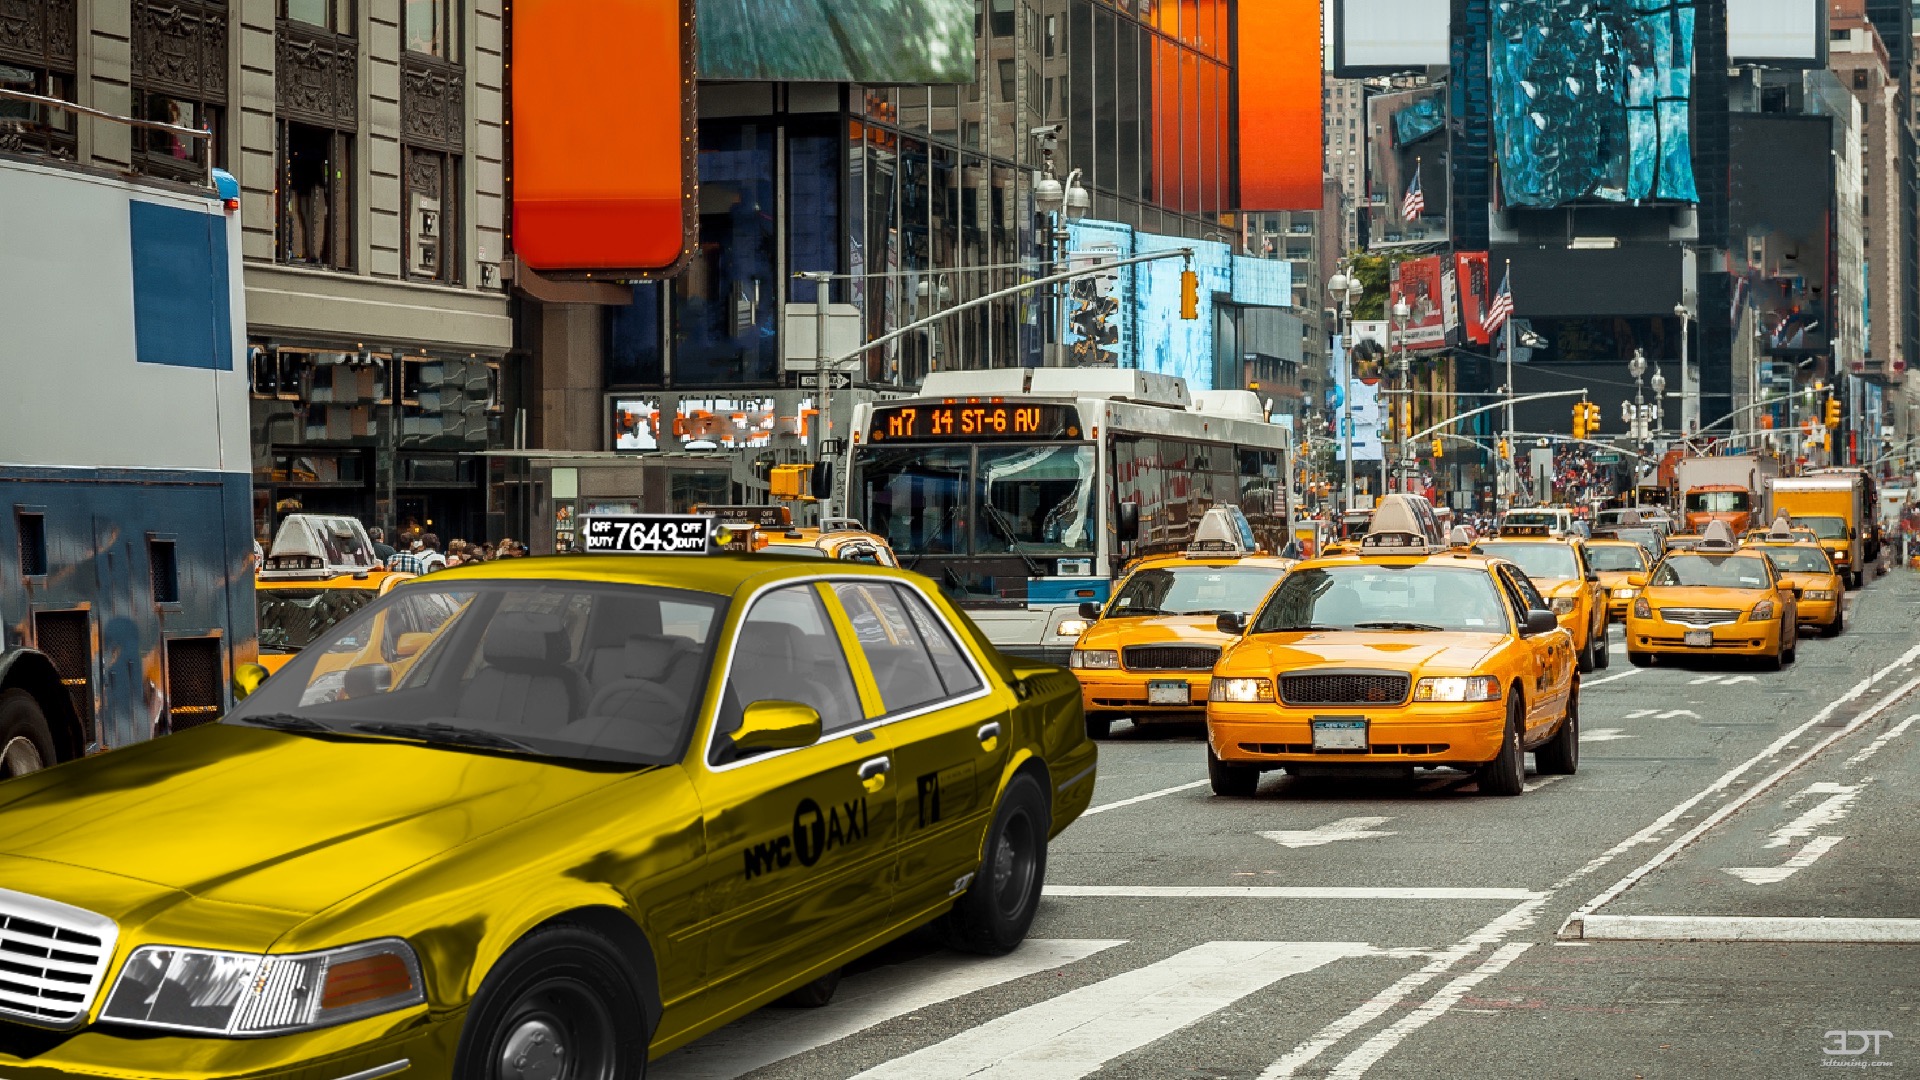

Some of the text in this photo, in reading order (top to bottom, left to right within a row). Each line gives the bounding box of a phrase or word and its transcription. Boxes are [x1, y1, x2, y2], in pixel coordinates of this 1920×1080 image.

[931, 409, 953, 434] 14
[961, 408, 1006, 433] ST-6
[1015, 408, 1040, 432] AV
[592, 521, 612, 533] OFF
[681, 523, 703, 534] OFF
[588, 536, 614, 547] DUTY
[614, 522, 679, 551] 7643
[676, 537, 706, 548] DUTY
[743, 834, 792, 880] NYC
